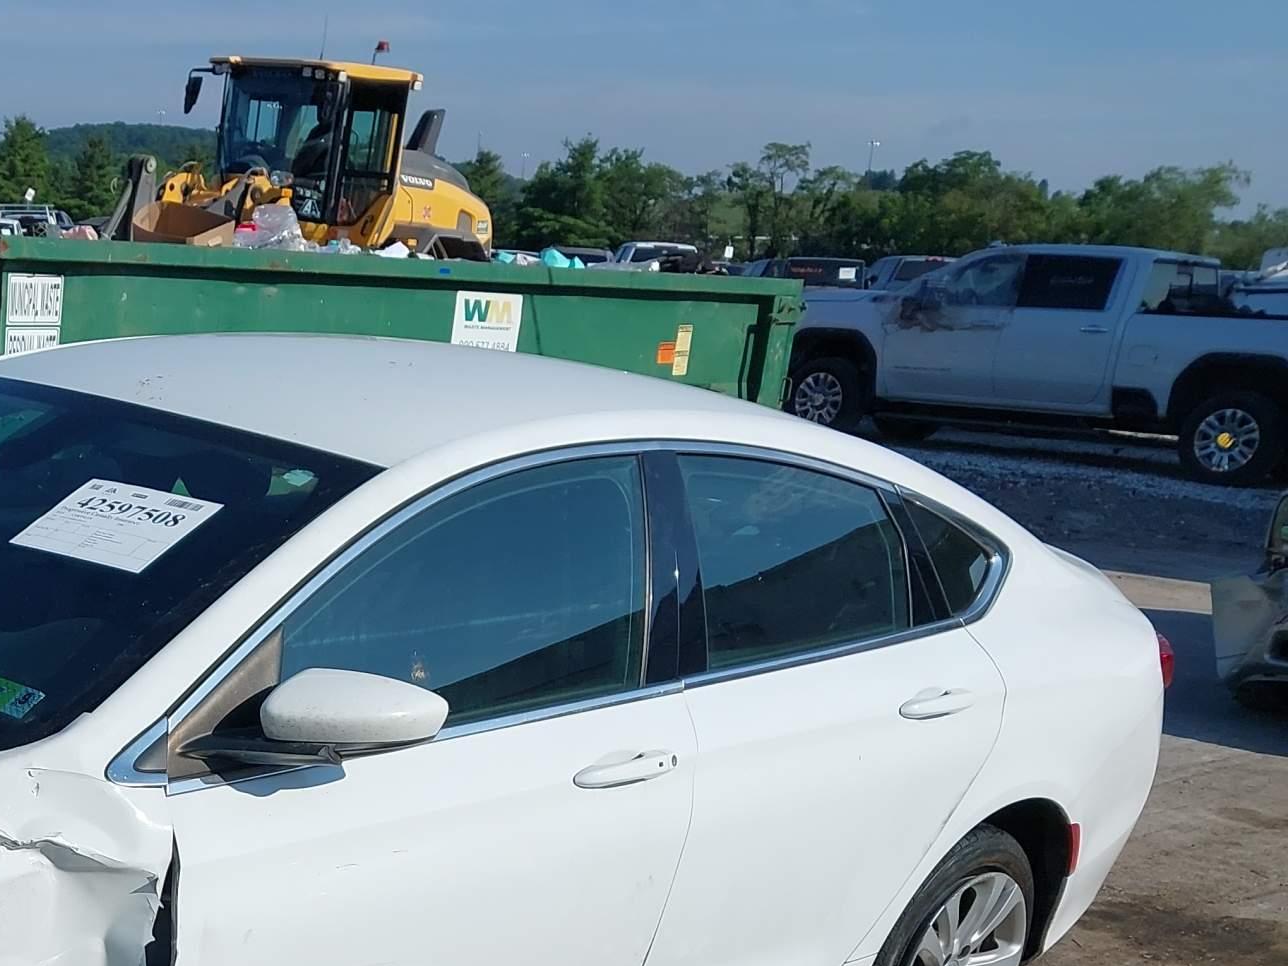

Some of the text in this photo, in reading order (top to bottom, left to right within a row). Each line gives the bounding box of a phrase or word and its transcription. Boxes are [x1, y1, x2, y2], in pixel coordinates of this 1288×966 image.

[400, 174, 433, 187] VOLVO
[39, 282, 60, 316] WASTE
[464, 298, 513, 324] WM
[77, 496, 186, 527] 42597508
